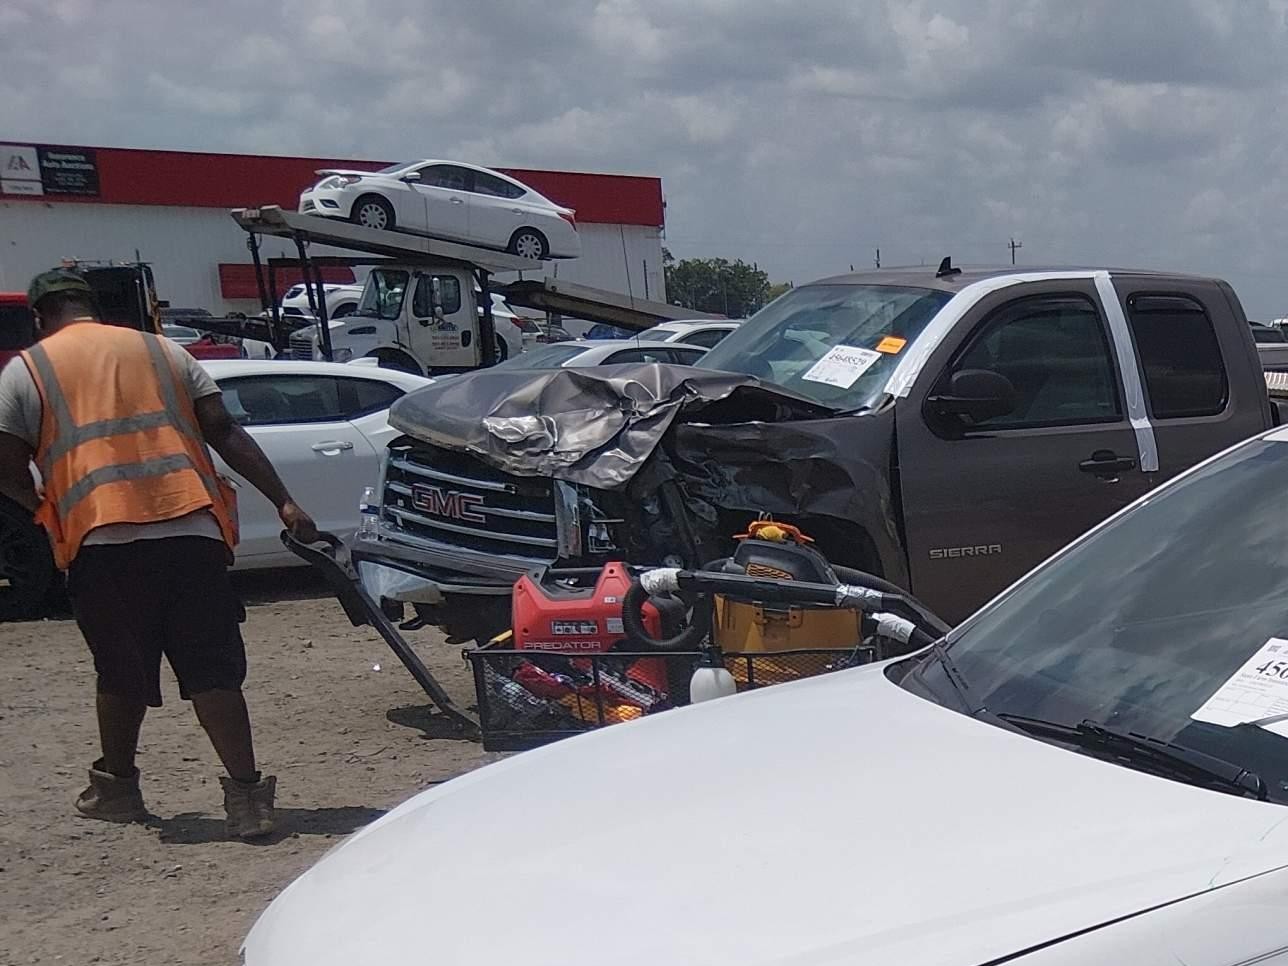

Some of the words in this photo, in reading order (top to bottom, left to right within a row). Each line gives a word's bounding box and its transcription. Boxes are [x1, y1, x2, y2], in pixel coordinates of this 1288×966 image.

[411, 483, 486, 523] GMC
[929, 544, 1001, 559] SIERRA
[524, 641, 600, 649] PREDATOR
